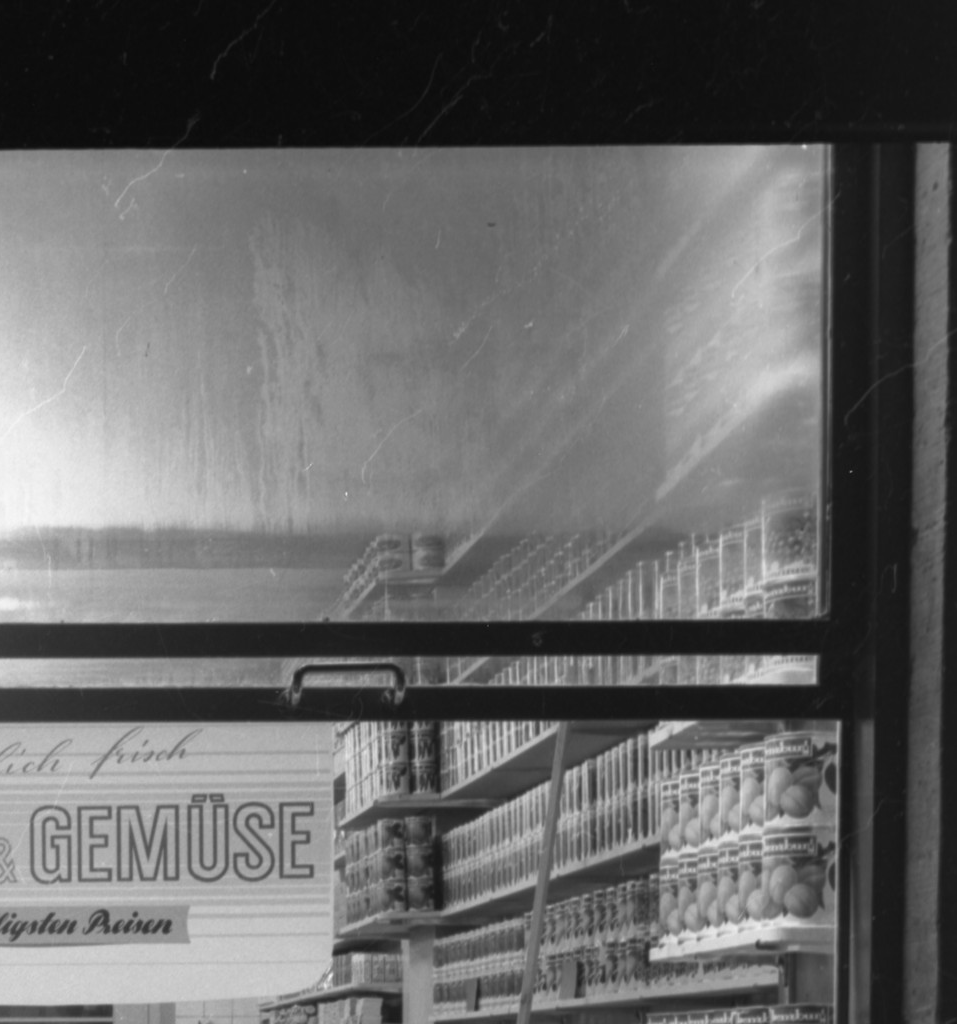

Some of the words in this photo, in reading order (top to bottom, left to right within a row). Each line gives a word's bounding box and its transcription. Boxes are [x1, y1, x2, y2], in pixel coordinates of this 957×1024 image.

[89, 725, 203, 780] frisch
[29, 793, 315, 885] GEMÜSE
[82, 908, 174, 936] Preisen
